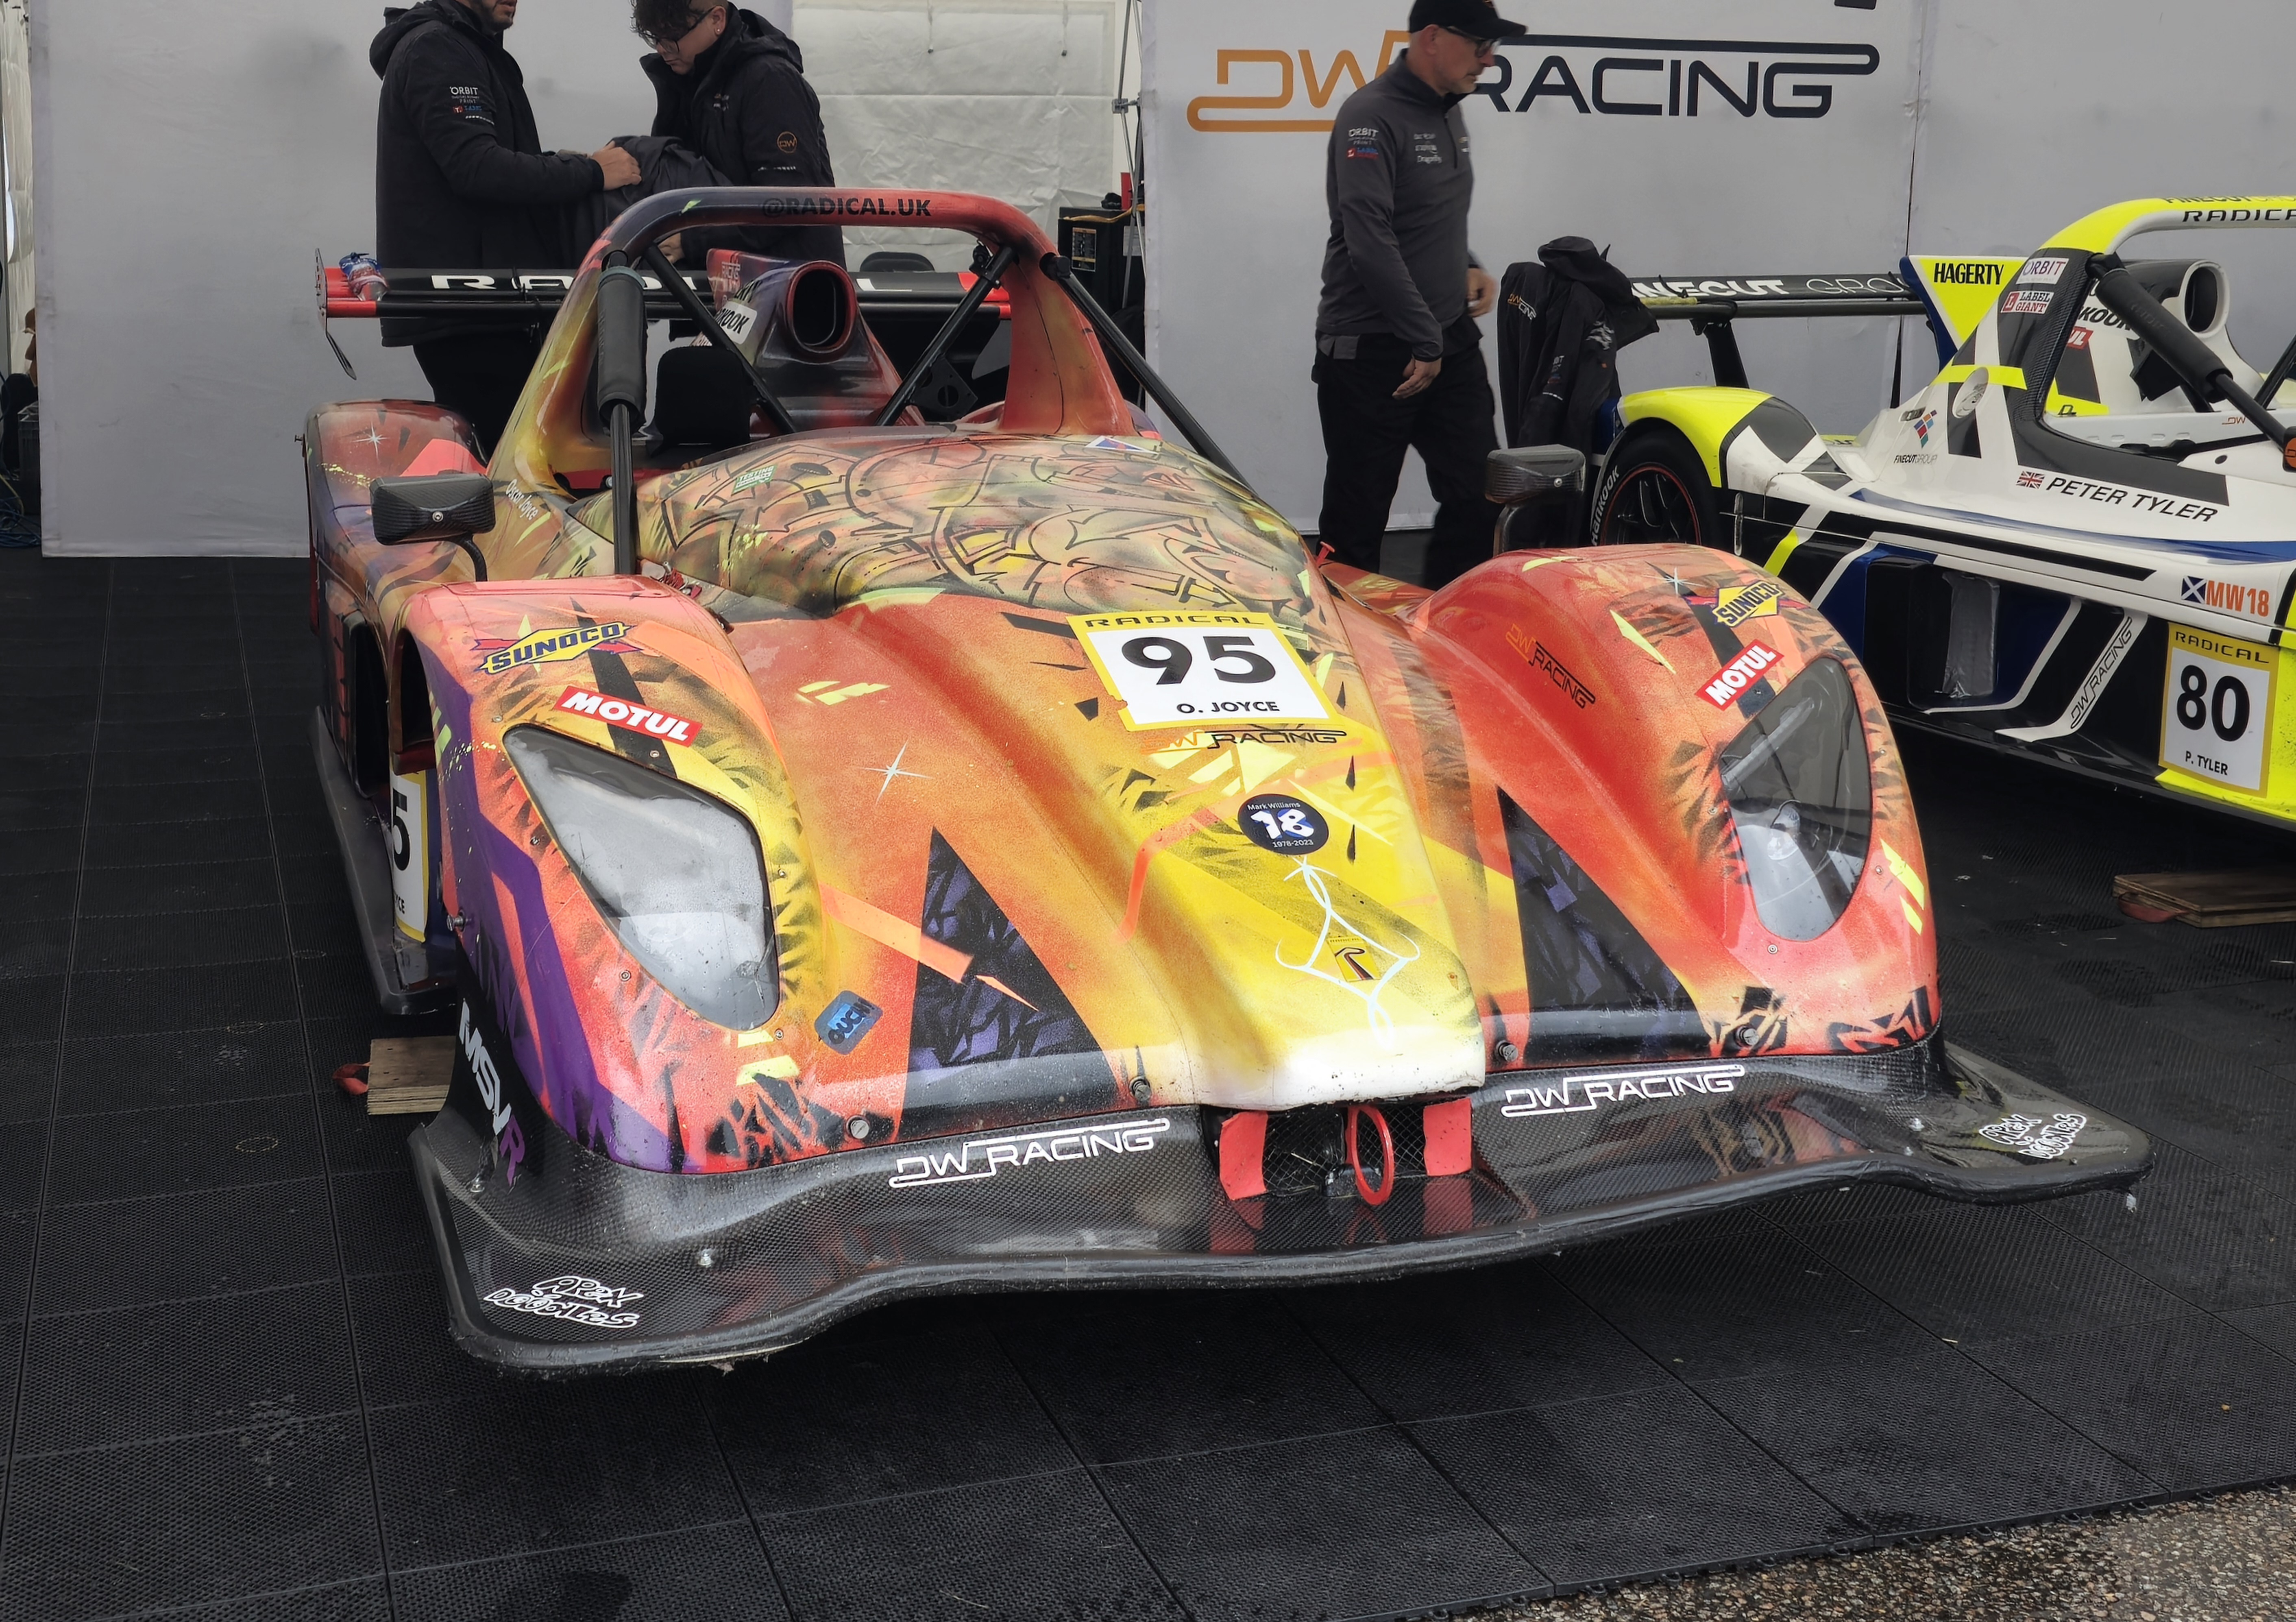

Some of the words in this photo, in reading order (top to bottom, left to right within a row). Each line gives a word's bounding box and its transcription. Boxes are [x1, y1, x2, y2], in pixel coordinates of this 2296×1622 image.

[449, 87, 478, 95] ORBIT
[762, 197, 932, 217] @RADICAL.UK
[1933, 262, 2004, 285] HAGERTY
[2023, 261, 2066, 275] ORBIT
[2015, 302, 2047, 312] GIANT
[2019, 292, 2051, 302] LABEL
[506, 479, 525, 504] Oscar
[518, 495, 538, 520] Joyce
[2046, 477, 2128, 504] PETER
[2132, 494, 2218, 522] TYLER
[1716, 582, 1780, 624] SUNOCO
[1085, 615, 1265, 628] RADICAL
[492, 624, 621, 671] SUNOCO
[1122, 636, 1276, 685] 95
[2089, 617, 2132, 695] RACING
[2175, 631, 2270, 664] RADICAL
[1528, 641, 1596, 709] RACING
[1705, 645, 1777, 706] MOTUL
[561, 691, 690, 741] MOTUL
[1176, 704, 1203, 714] O.
[1211, 701, 1280, 713] JOYCE
[2176, 665, 2250, 741] 80
[1206, 730, 1347, 749] RACING
[2185, 750, 2194, 764] P.
[2197, 755, 2228, 775] TYLER
[392, 788, 411, 871] 5
[1250, 808, 1314, 840] 18
[1272, 839, 1314, 848] 1978-2023
[1584, 1064, 1745, 1102] RACING
[986, 1118, 1170, 1166] RACING
